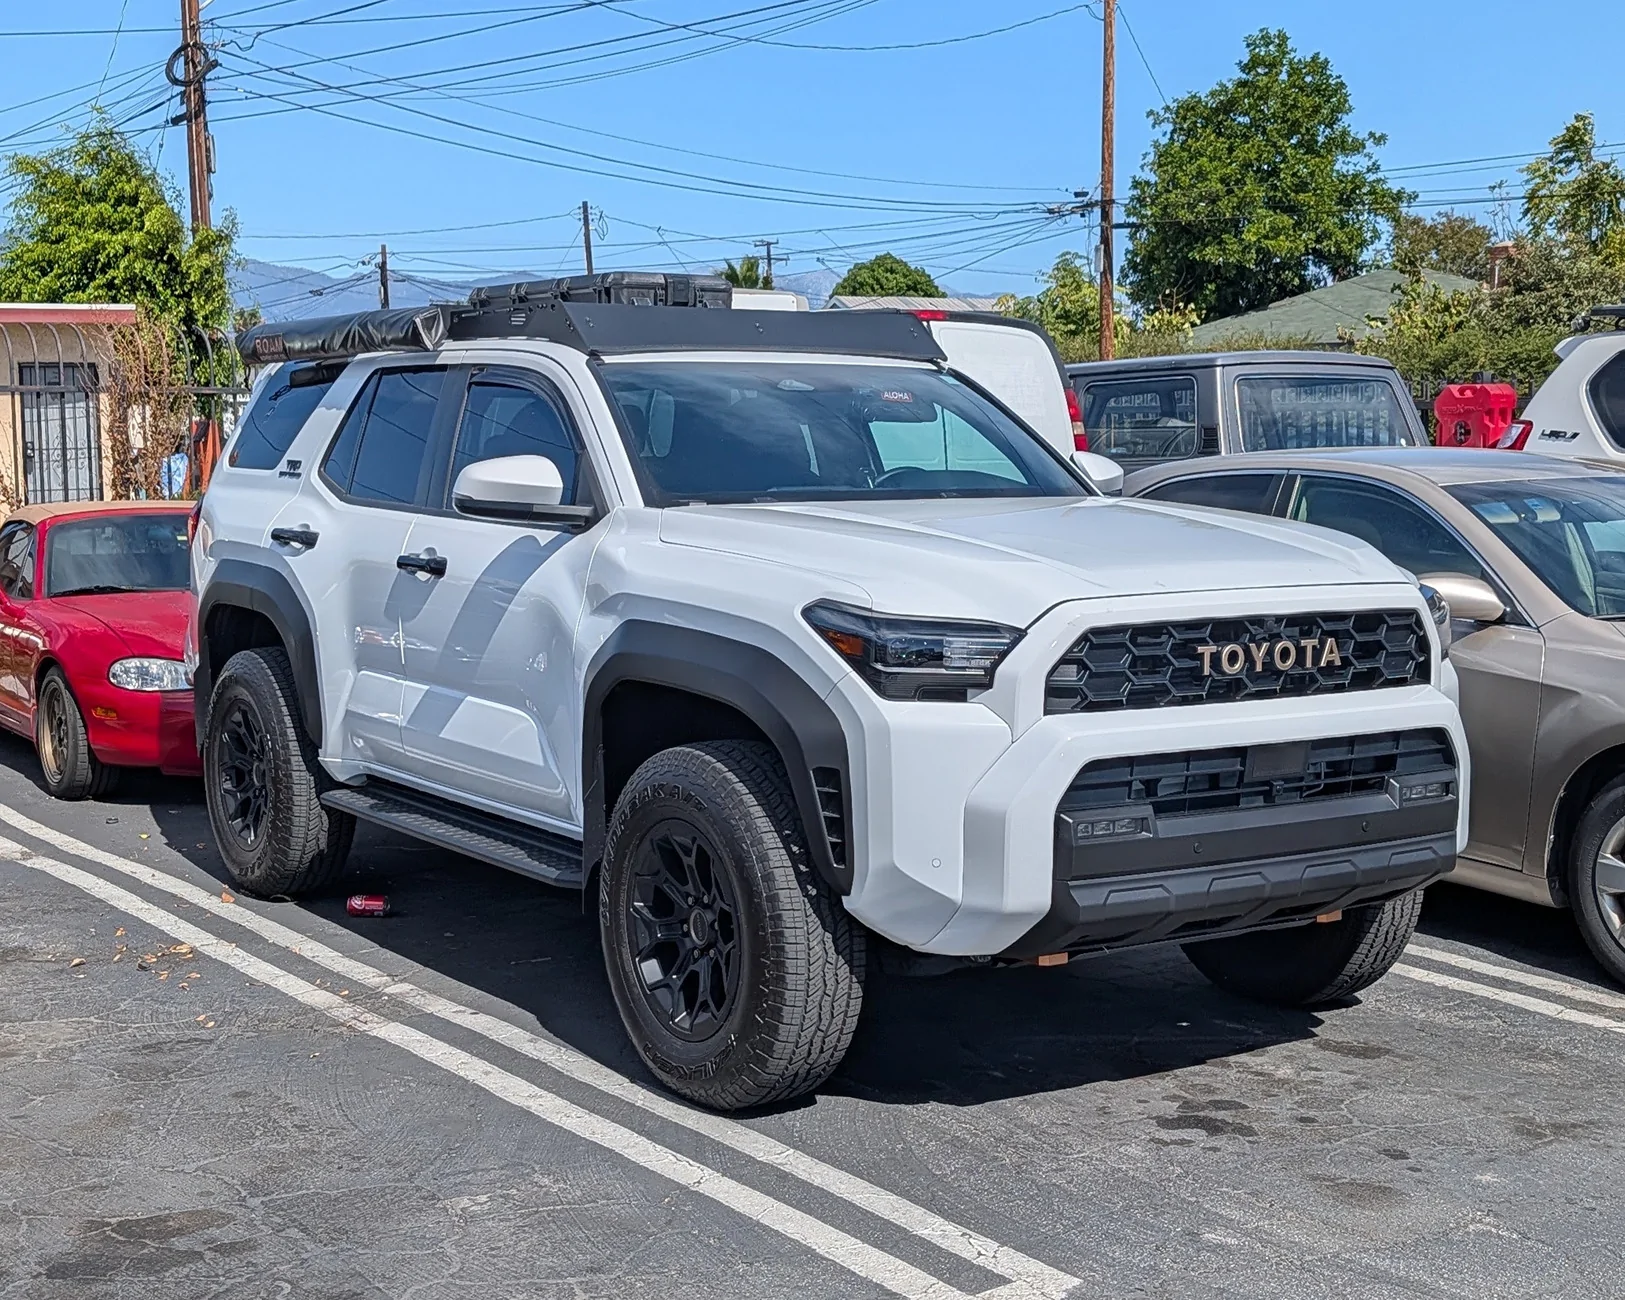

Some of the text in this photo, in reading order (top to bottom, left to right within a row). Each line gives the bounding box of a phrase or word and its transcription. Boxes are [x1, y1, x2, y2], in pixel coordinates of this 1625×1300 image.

[255, 337, 283, 354] ROAM
[883, 391, 909, 400] ALOHA
[1197, 637, 1342, 676] TOYOTA
